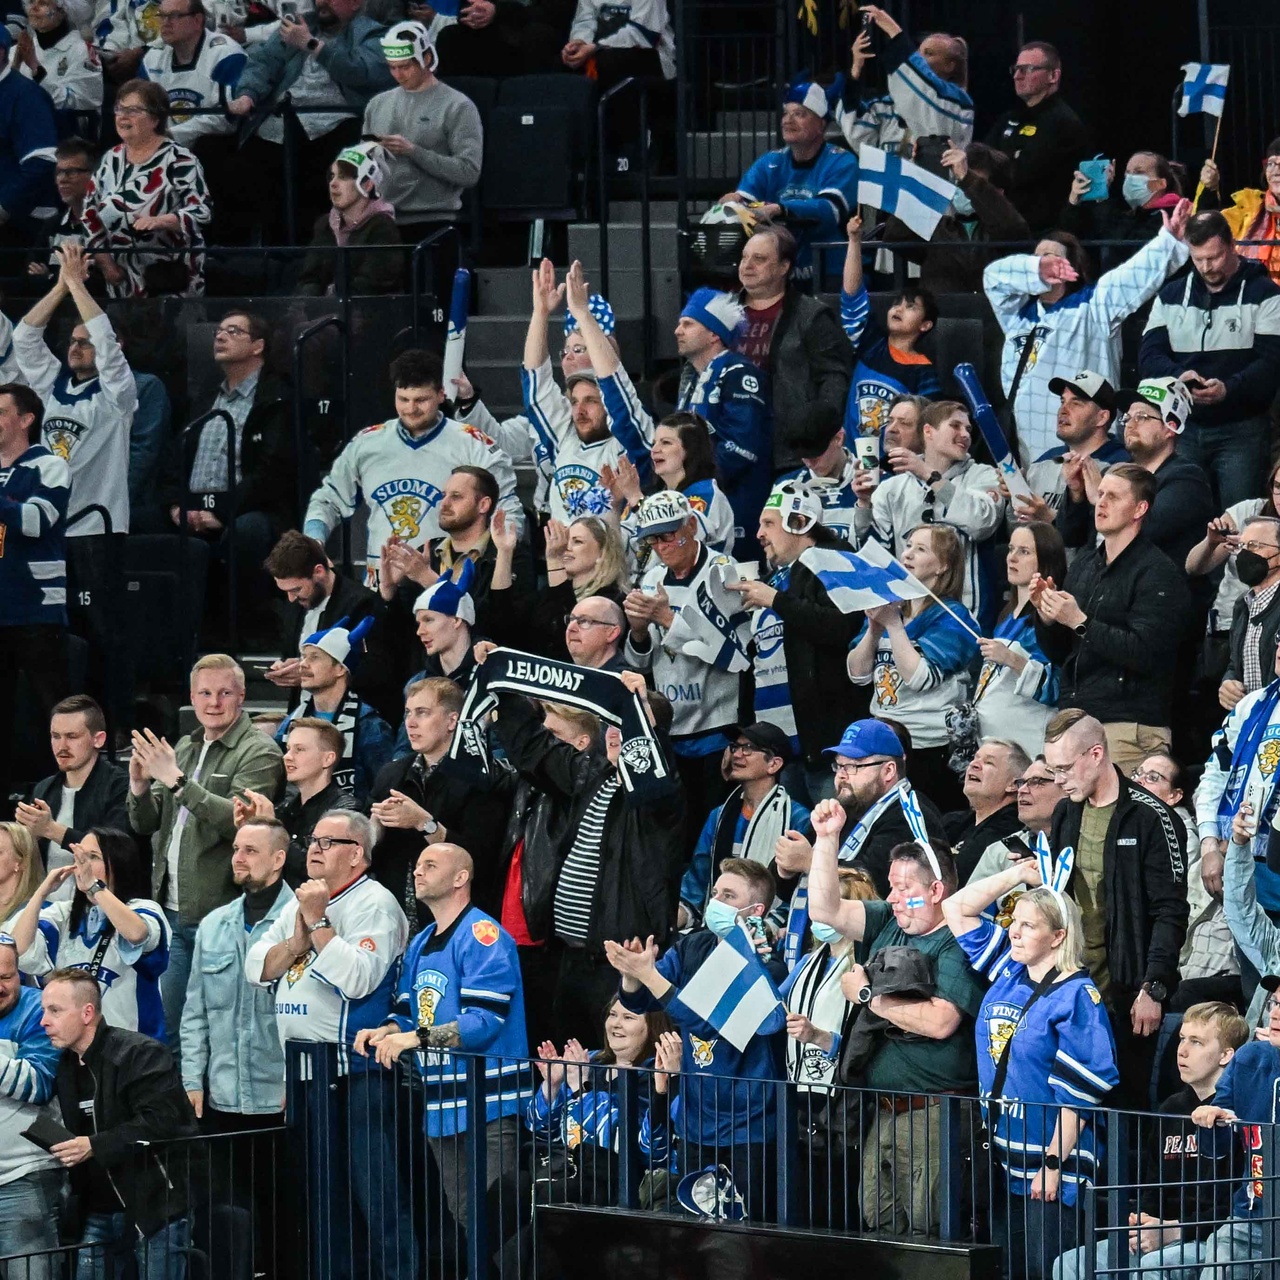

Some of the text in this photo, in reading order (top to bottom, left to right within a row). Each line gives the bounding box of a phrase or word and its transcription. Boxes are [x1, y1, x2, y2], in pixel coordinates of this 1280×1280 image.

[618, 158, 629, 172] 20
[432, 309, 444, 323] 18
[319, 401, 330, 414] 17
[44, 420, 81, 436] SUOMI
[557, 467, 593, 482] FINLAND
[377, 480, 440, 503] SUOMI
[203, 494, 215, 508] 16
[79, 591, 91, 605] 15
[506, 658, 584, 692] LEIJONAT
[622, 738, 648, 756] SUOMI
